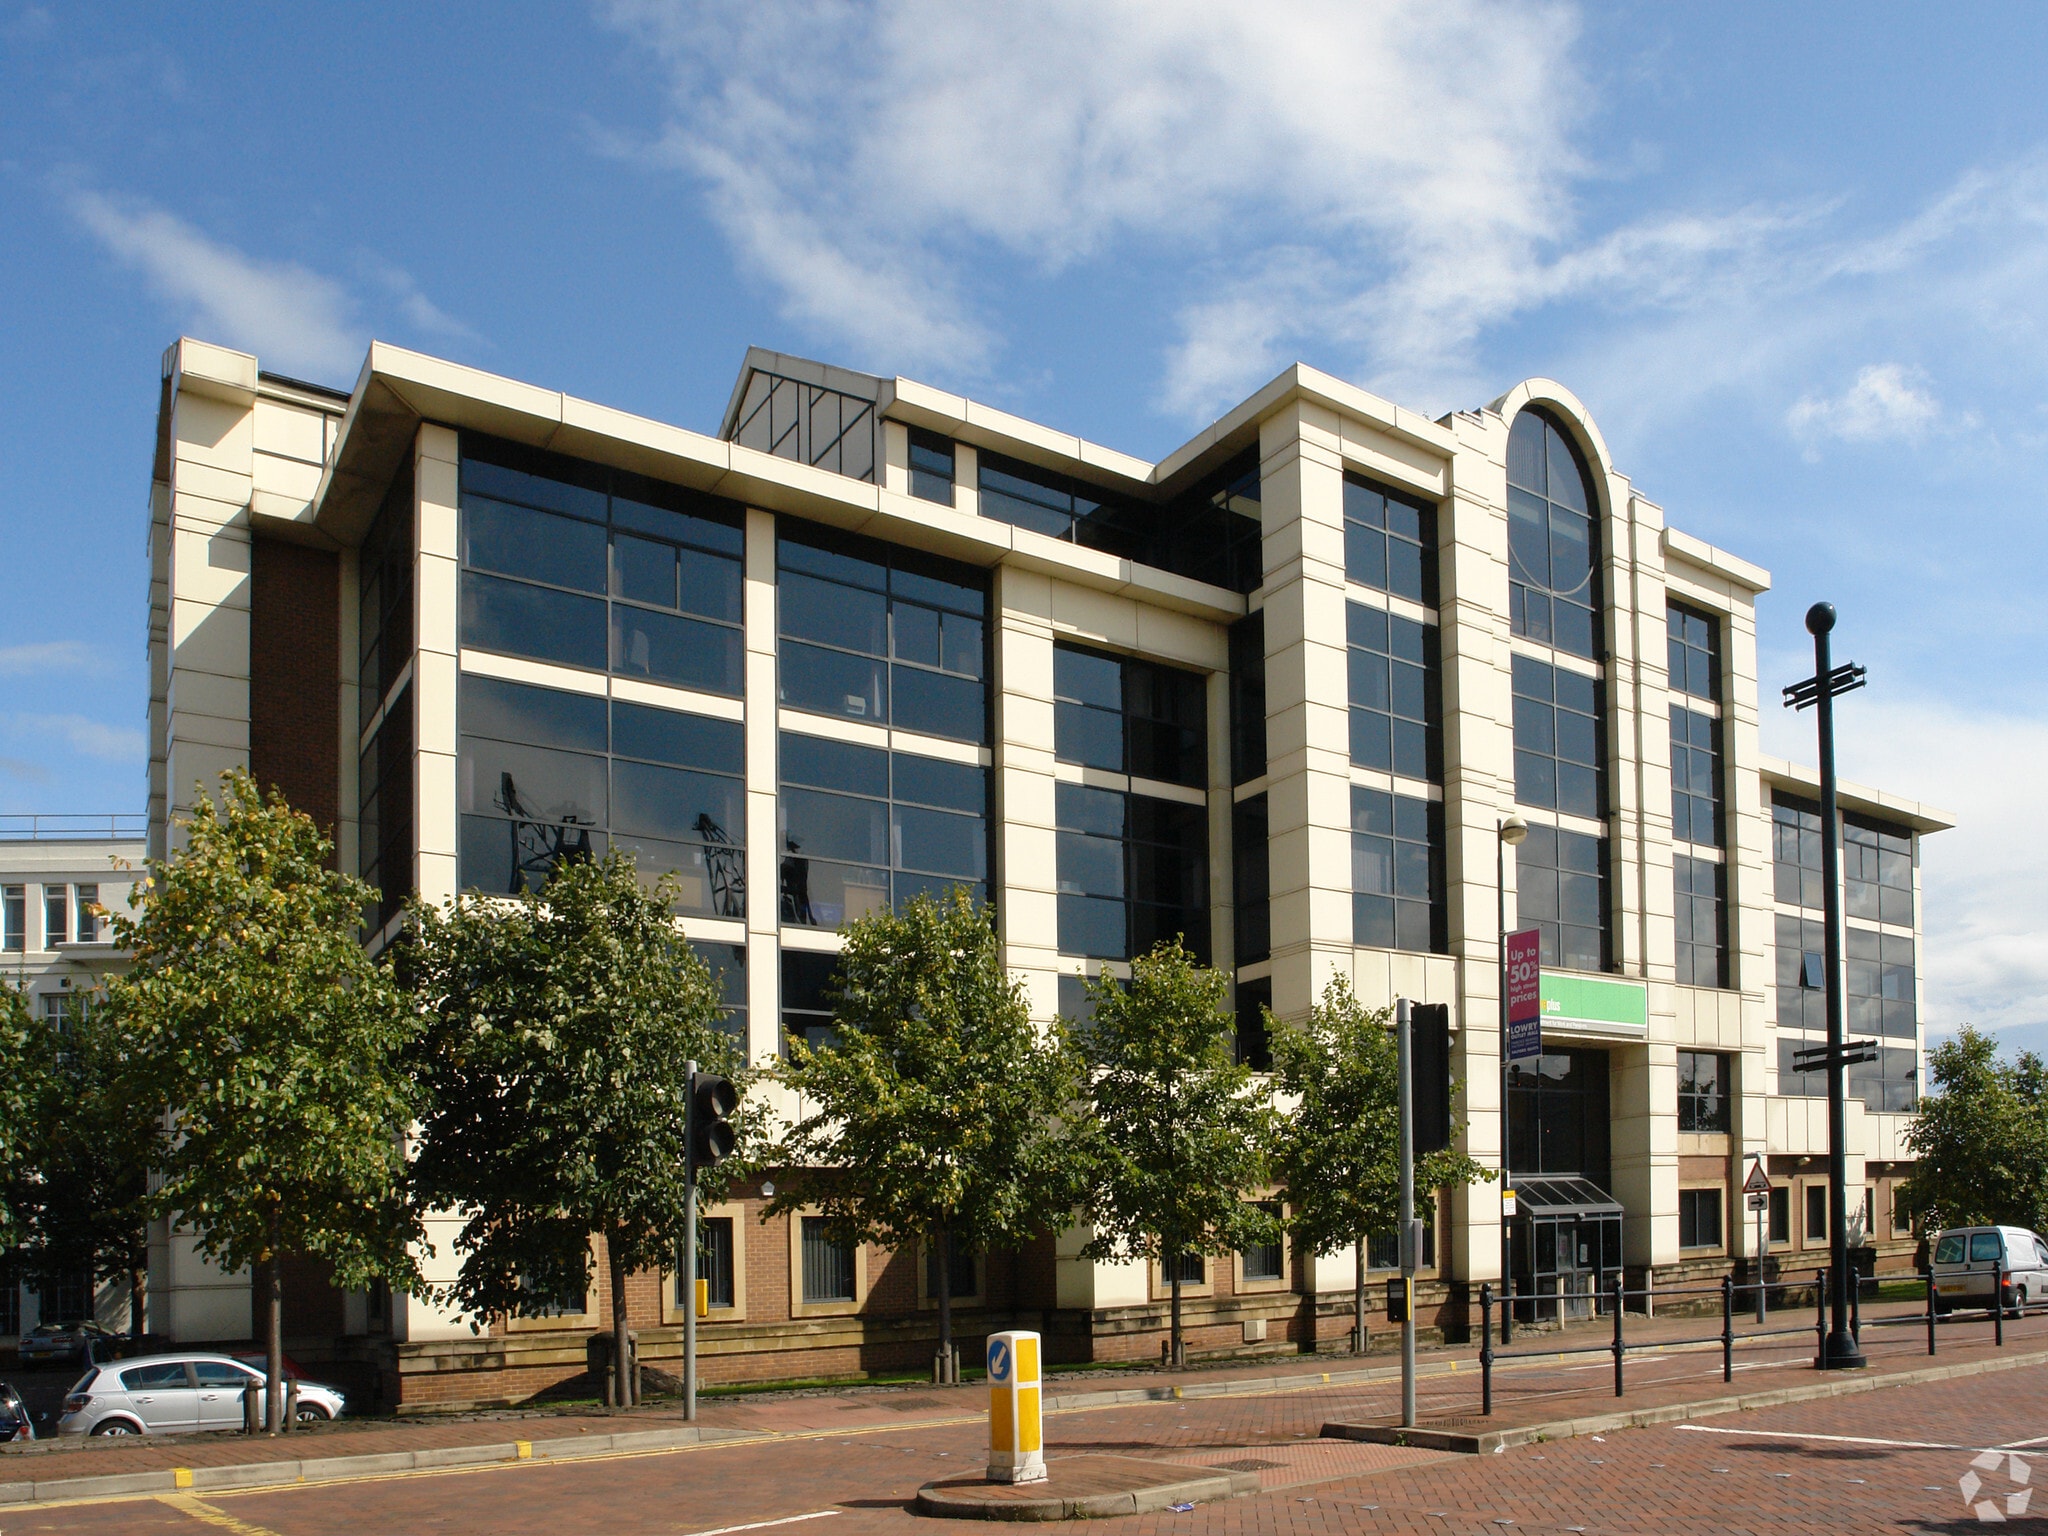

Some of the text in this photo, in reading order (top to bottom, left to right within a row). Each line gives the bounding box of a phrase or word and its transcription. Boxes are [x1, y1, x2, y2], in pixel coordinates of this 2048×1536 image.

[1511, 948, 1536, 962] Up to
[1511, 961, 1537, 983] 50%
[1511, 991, 1536, 1007] prices
[1511, 1021, 1537, 1034] LOWRY
